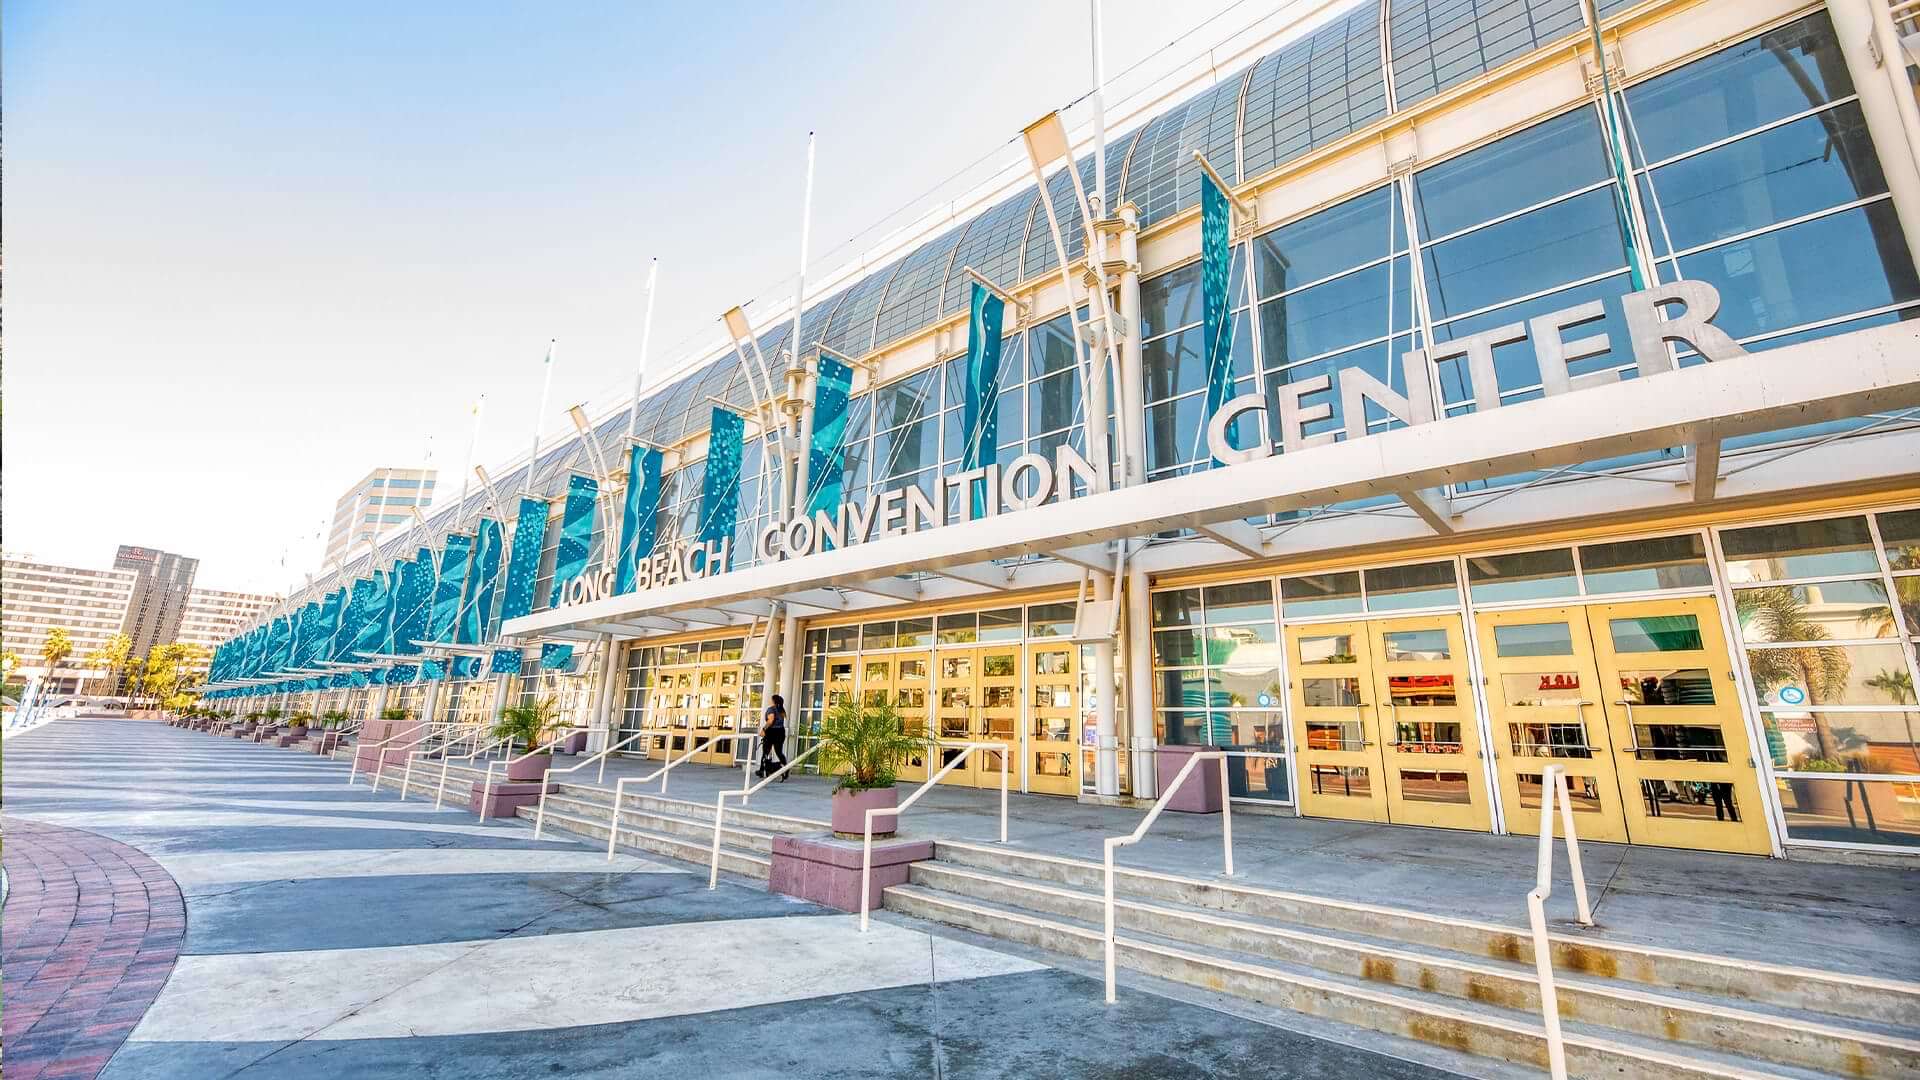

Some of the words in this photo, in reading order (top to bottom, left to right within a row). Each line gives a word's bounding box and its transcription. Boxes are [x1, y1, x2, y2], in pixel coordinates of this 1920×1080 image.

[560, 567, 615, 607] LONG
[636, 535, 730, 593] BEACH
[757, 433, 1112, 562] CONVENTION
[1207, 280, 1748, 466] CENTER
